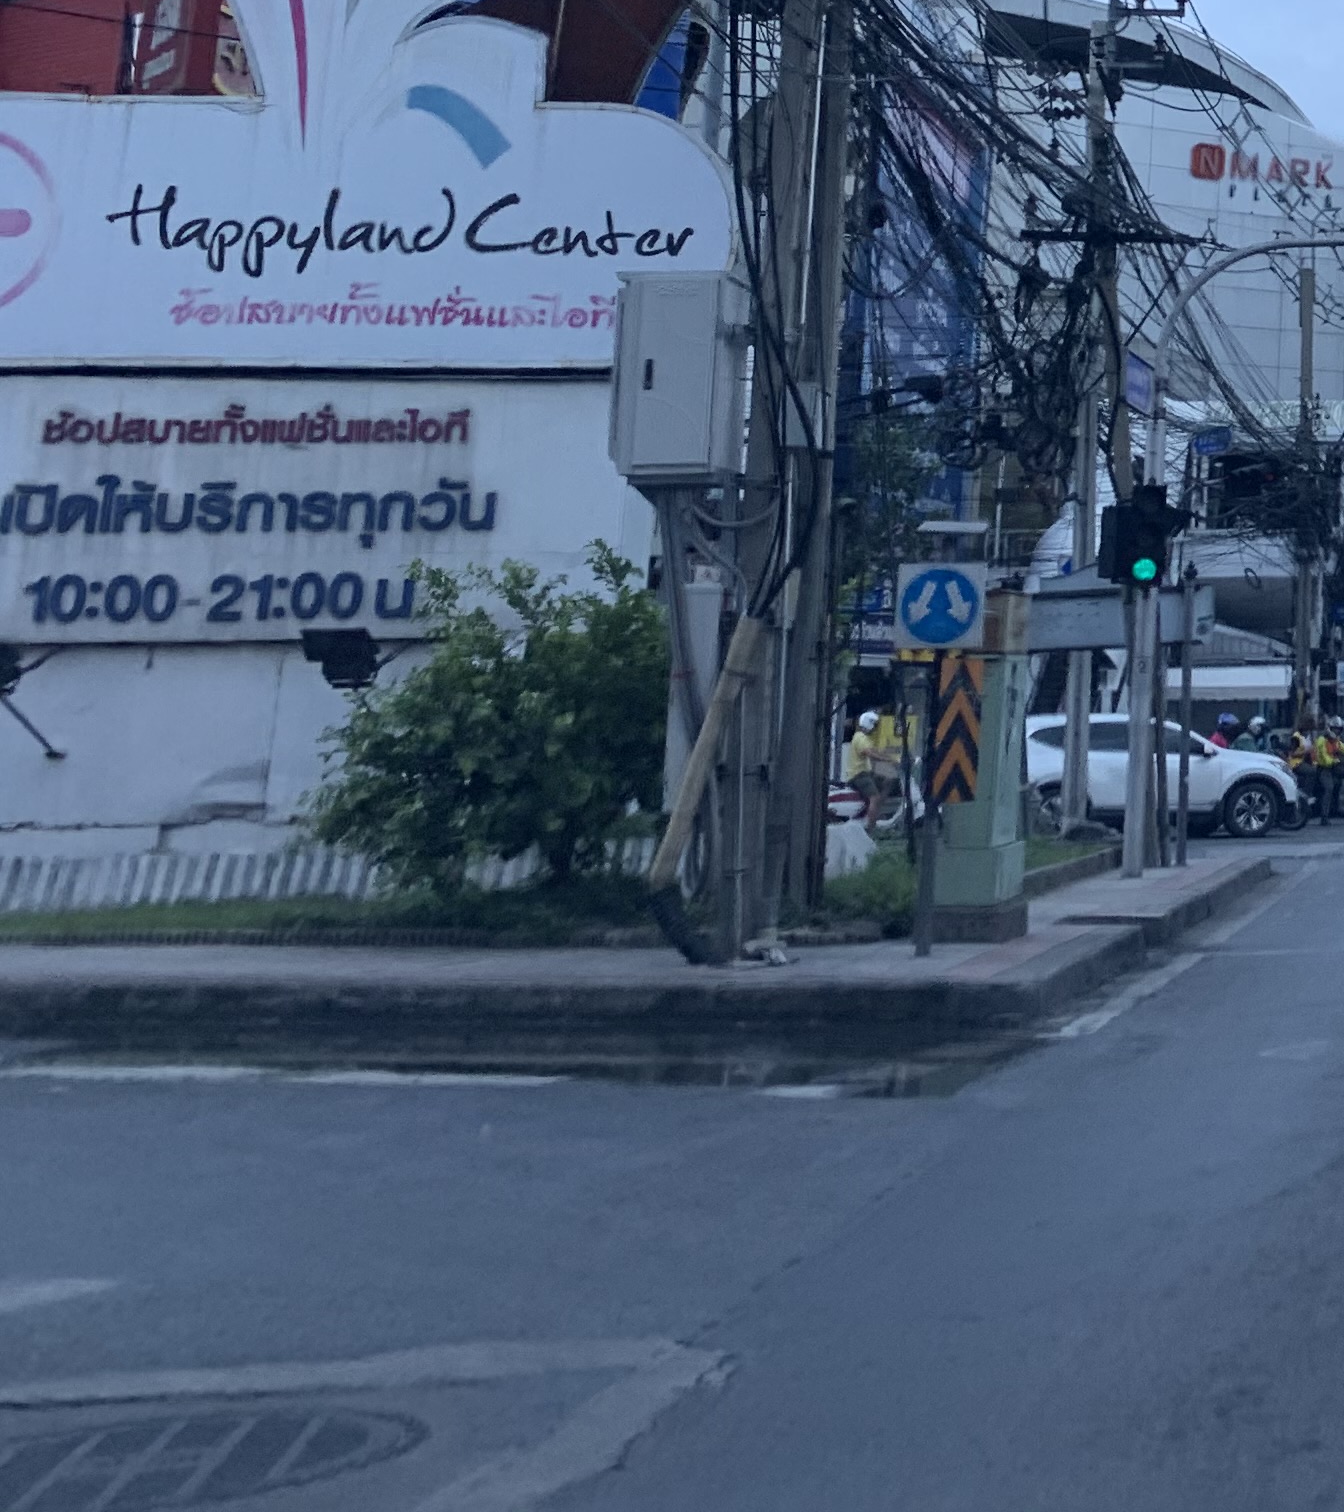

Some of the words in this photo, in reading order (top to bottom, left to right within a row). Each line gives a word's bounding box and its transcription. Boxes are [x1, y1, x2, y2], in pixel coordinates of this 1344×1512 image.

[1229, 150, 1334, 190] MARK
[106, 183, 457, 276] Happyland
[464, 192, 694, 258] Center
[0, 474, 498, 549] เปิดให้บริการทุกวัน
